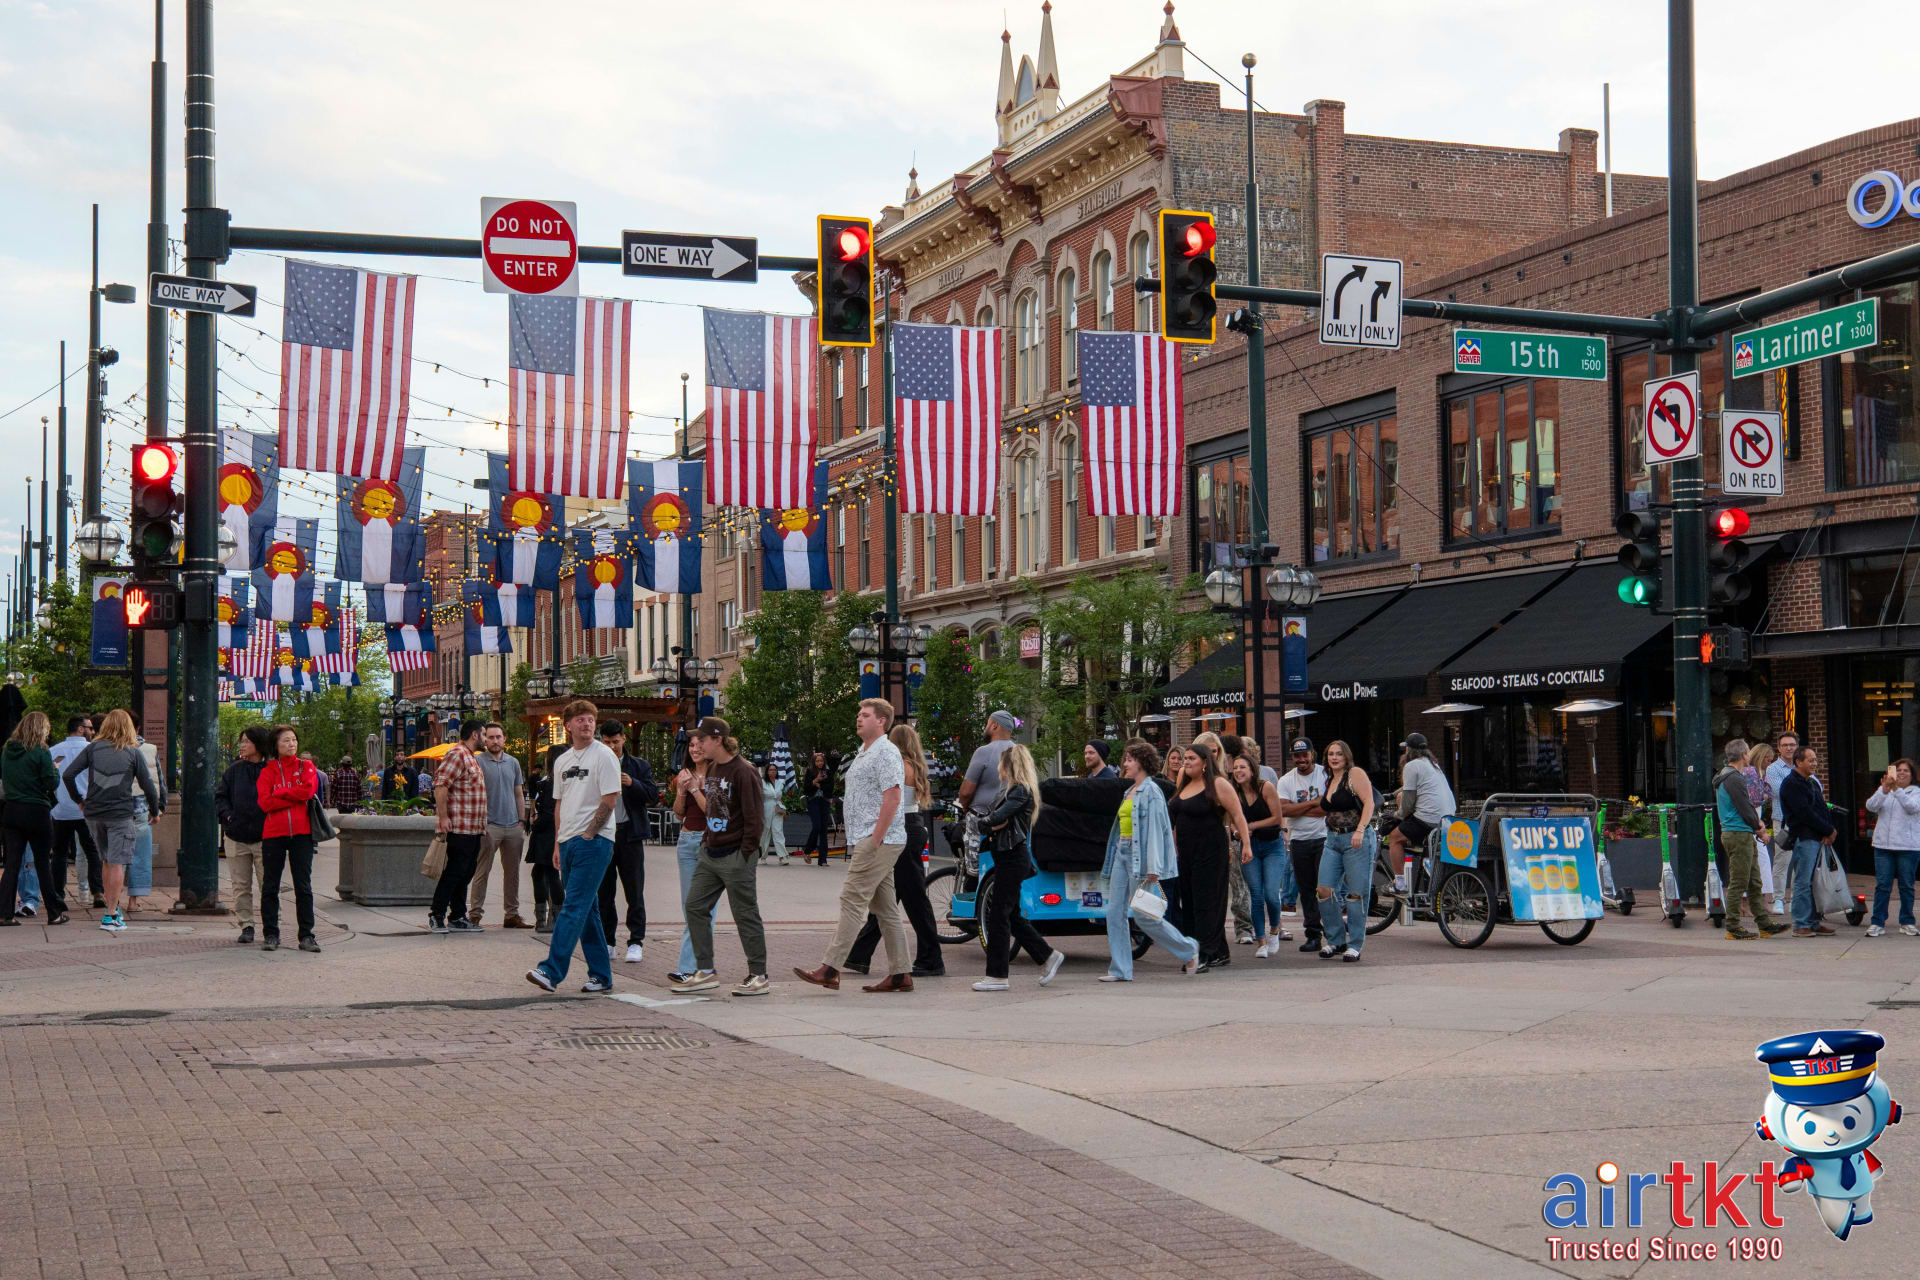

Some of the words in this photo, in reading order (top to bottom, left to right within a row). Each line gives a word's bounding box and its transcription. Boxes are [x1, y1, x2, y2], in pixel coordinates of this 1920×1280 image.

[1078, 181, 1123, 219] STANBURY
[496, 217, 519, 232] DO
[529, 219, 563, 235] NOT
[633, 246, 668, 264] ONE
[677, 249, 713, 266] WAY
[503, 260, 558, 278] ENTER
[161, 284, 190, 300] ONE
[196, 288, 224, 303] WAY
[1857, 309, 1865, 323] St
[1326, 322, 1357, 338] ONLY
[1364, 325, 1395, 341] ONLY
[1850, 323, 1873, 340] 1300
[1760, 320, 1843, 364] Larimer
[1458, 355, 1480, 364] DENVER
[1510, 340, 1559, 369] 15th
[1586, 345, 1596, 357] St
[1581, 359, 1601, 371] 1500
[1730, 472, 1747, 488] ON
[1752, 473, 1777, 489] RED
[1451, 676, 1495, 691] SEAFOOD
[1502, 673, 1539, 688] STEAKS
[1547, 669, 1605, 685] COCKTAILS
[1163, 696, 1192, 707] SEAFOOD
[1196, 694, 1220, 705] STEAKS
[1510, 826, 1558, 850] SUN'S
[1562, 826, 1585, 849] UP
